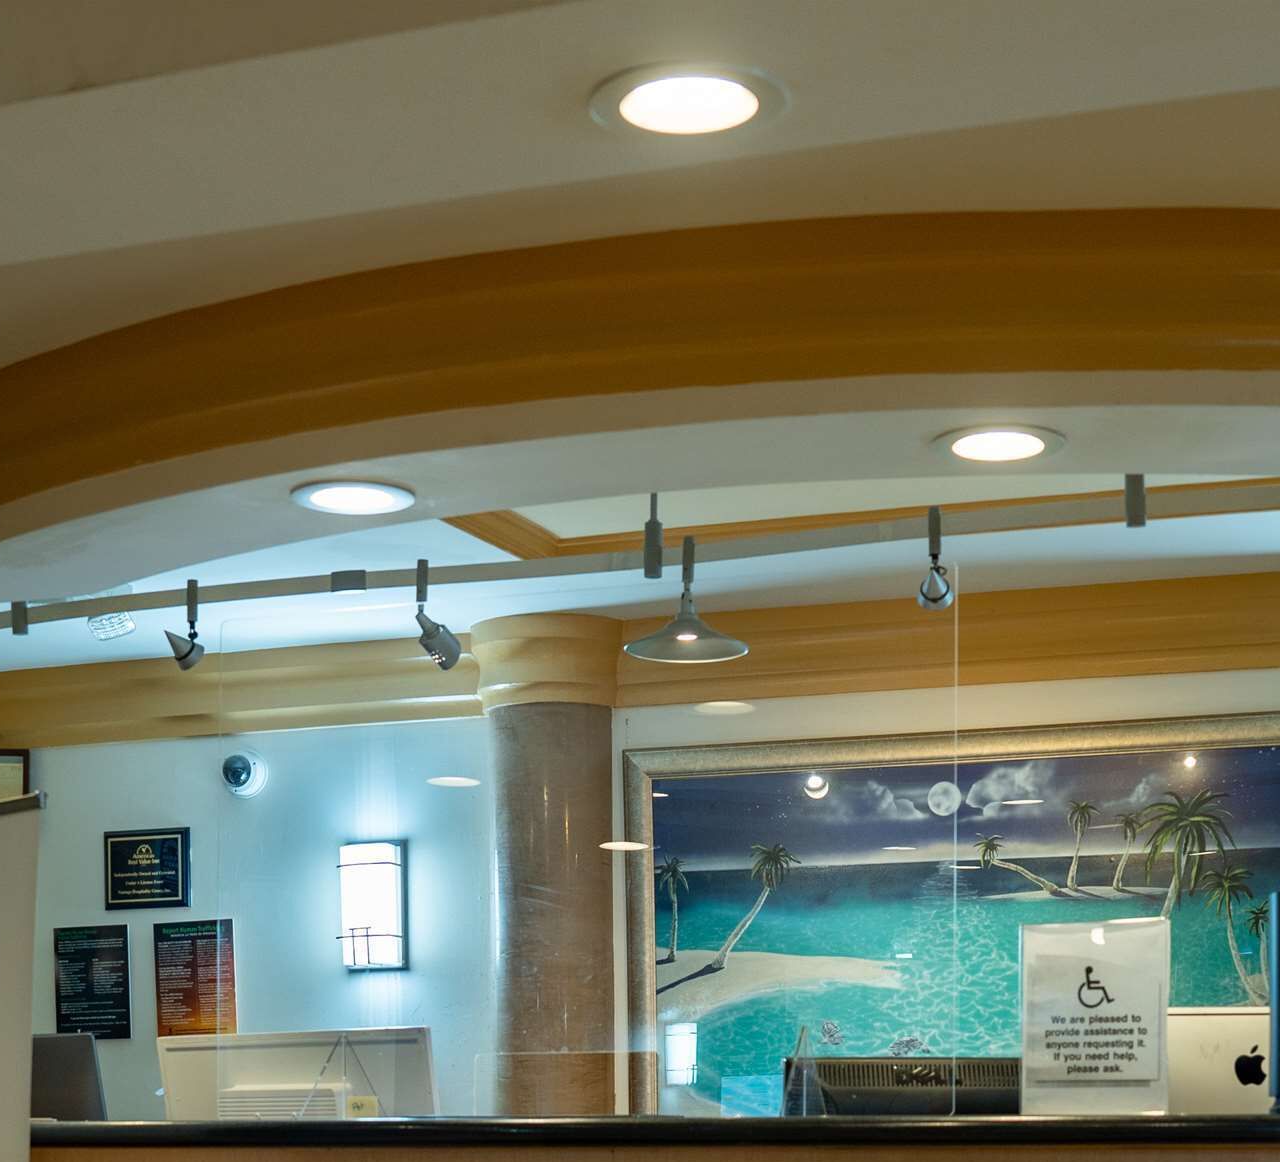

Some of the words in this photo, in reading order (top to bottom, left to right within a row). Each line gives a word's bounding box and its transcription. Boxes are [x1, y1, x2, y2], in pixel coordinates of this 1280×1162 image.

[1051, 1016, 1066, 1024] We
[1089, 1015, 1128, 1025] pleased
[1131, 1015, 1141, 1023] to
[1045, 1028, 1080, 1038] provide
[1084, 1028, 1134, 1036] assistance
[1138, 1027, 1147, 1035] to
[1045, 1041, 1079, 1050] anyone
[1083, 1040, 1134, 1049] requesting
[1053, 1053, 1060, 1061] If
[1064, 1054, 1081, 1062] you
[1085, 1052, 1109, 1060] need
[1113, 1052, 1138, 1061] help,
[1067, 1064, 1099, 1075] please
[1103, 1064, 1123, 1072] ask.
